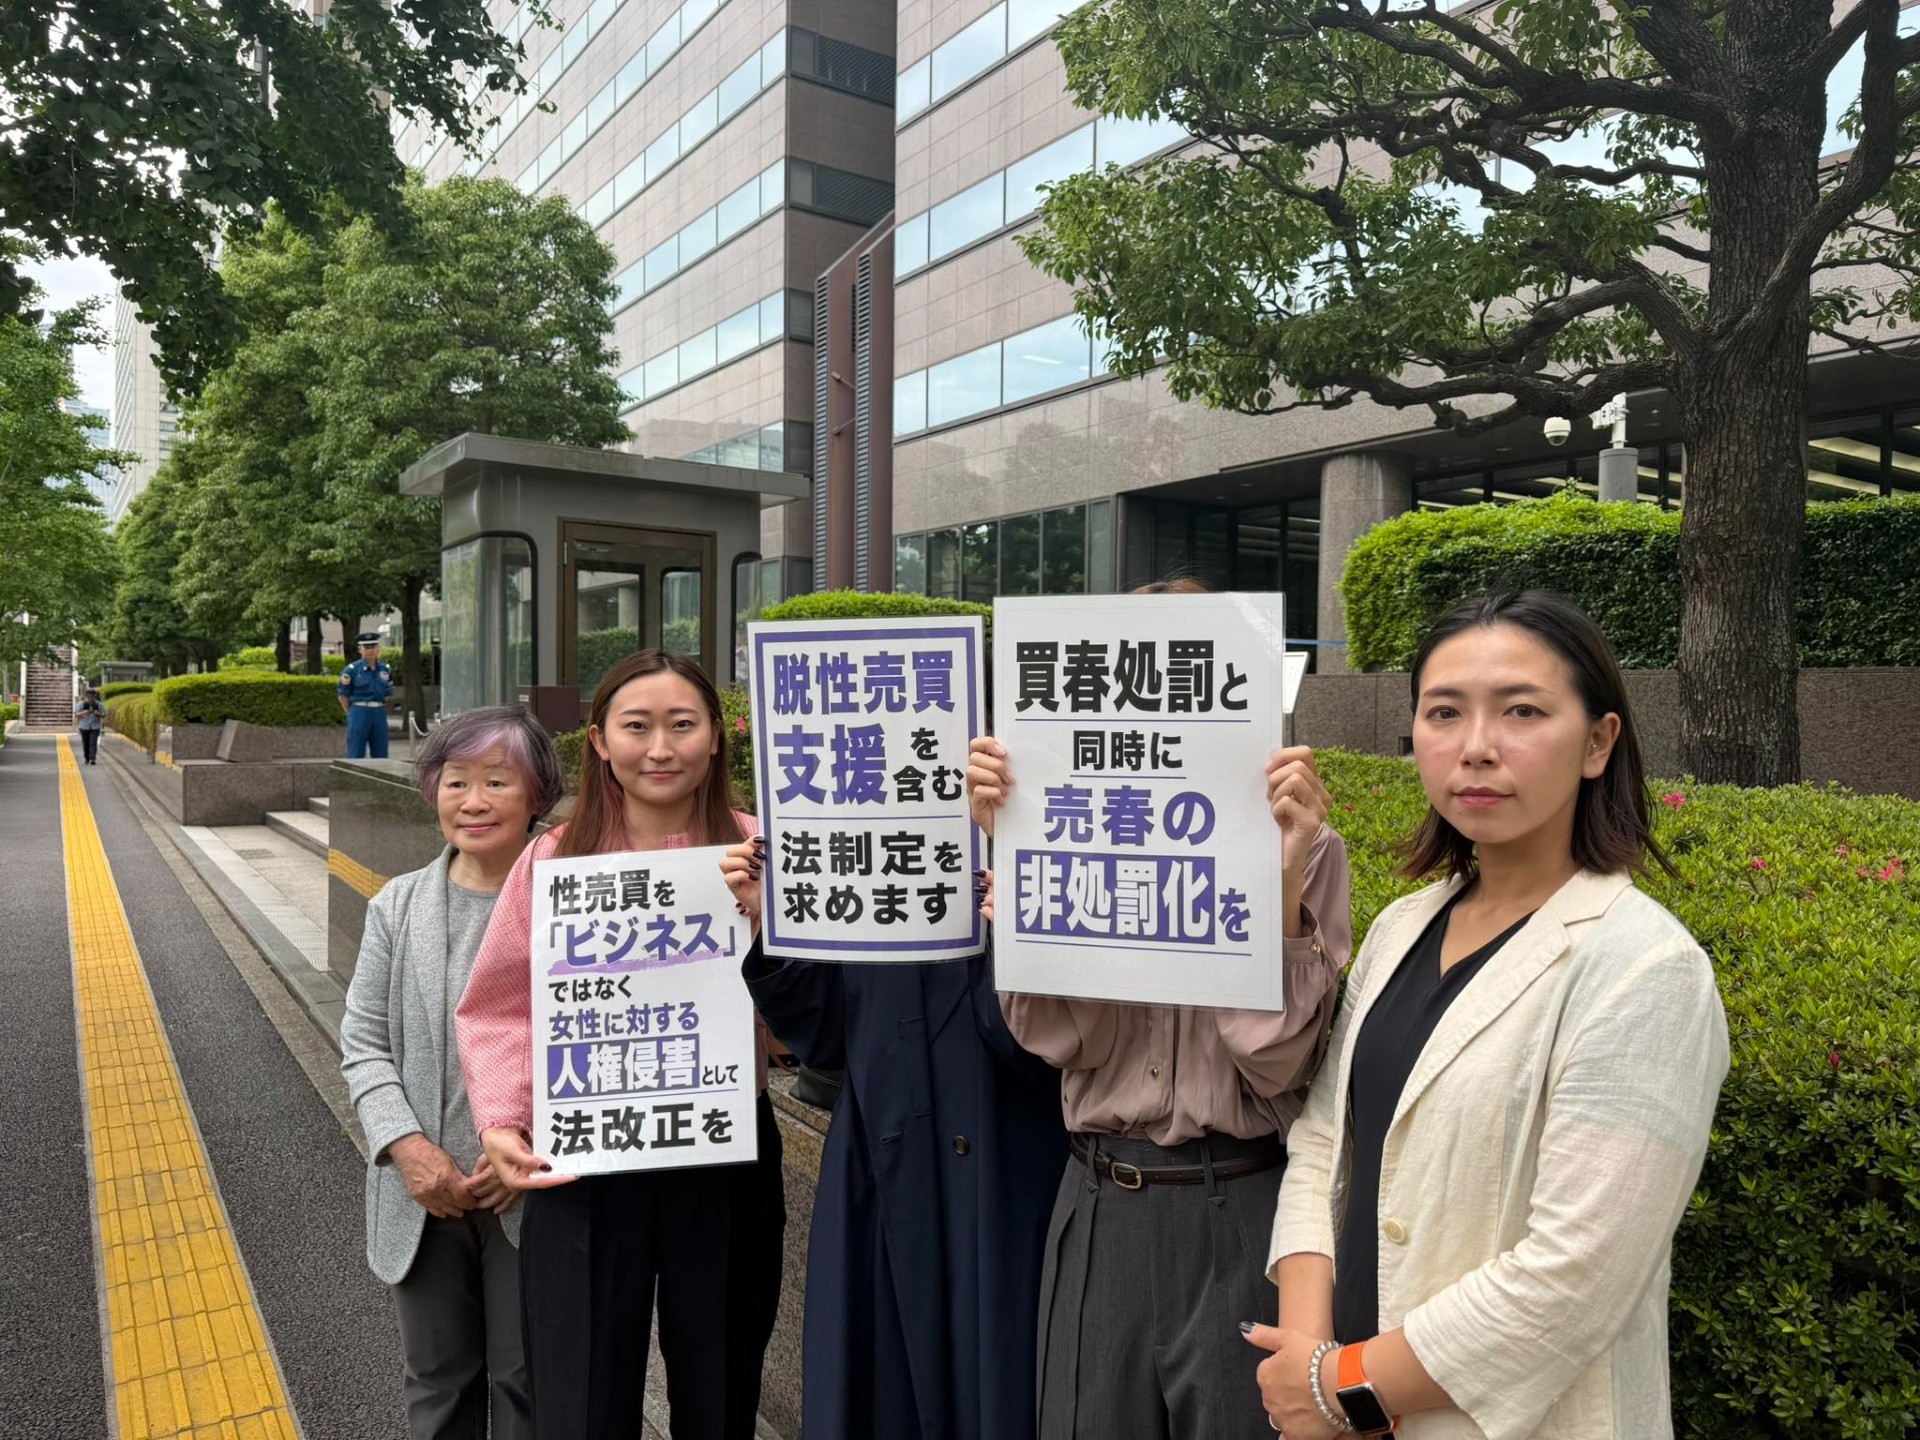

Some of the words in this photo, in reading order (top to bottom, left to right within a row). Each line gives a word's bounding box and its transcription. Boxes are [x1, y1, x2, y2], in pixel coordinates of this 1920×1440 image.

[772, 650, 955, 715] 脱性売買
[1015, 639, 1248, 713] 買春処罰と
[1072, 730, 1182, 771] 同時に
[1044, 784, 1215, 846] 売春の
[780, 830, 962, 876] 法制定を
[549, 869, 675, 917] 性売買を
[783, 881, 957, 924] 求めます
[550, 913, 736, 965] 「ビジネス」
[549, 976, 632, 1003] ではなく
[549, 1002, 699, 1041] 女性に対する
[550, 1102, 733, 1158] 法改正を
